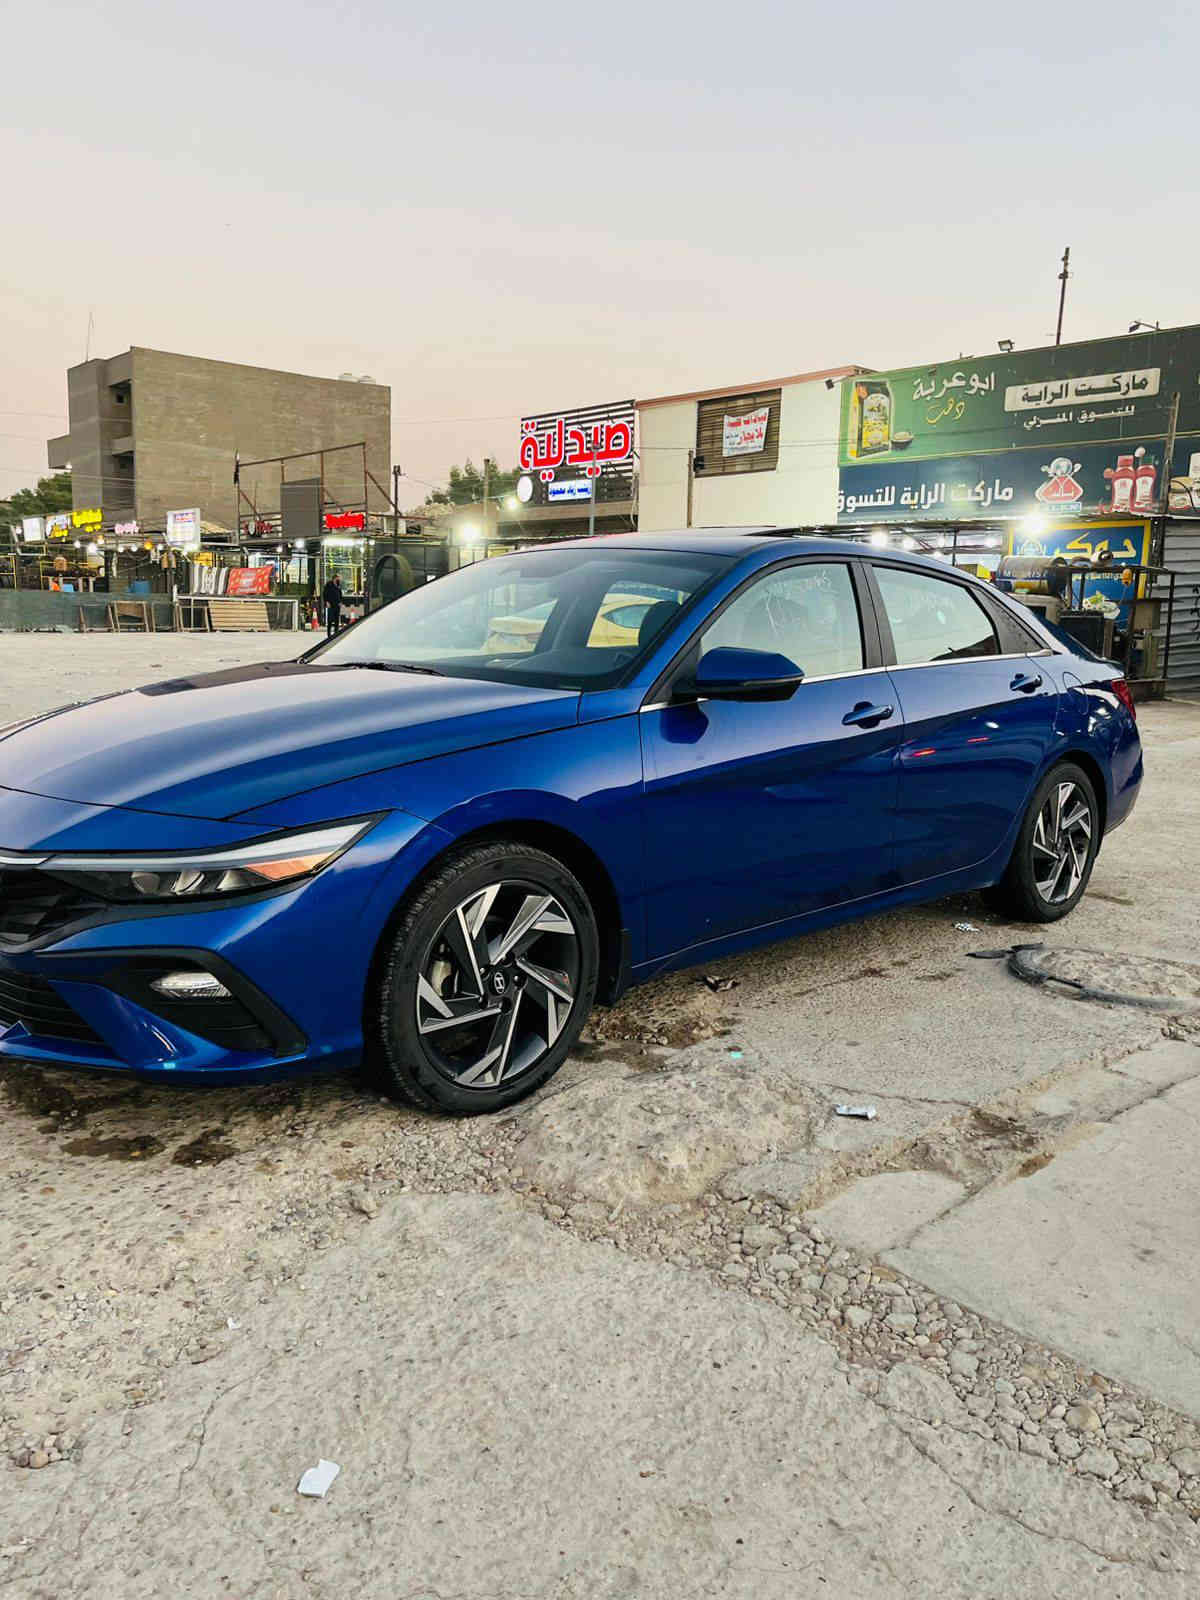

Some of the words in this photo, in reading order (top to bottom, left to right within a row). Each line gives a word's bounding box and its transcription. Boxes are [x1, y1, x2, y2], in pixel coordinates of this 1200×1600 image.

[1021, 382, 1069, 405] الراية
[1075, 374, 1149, 396] ماركت
[520, 416, 632, 482] صيدلية
[837, 485, 896, 513] للتسوق
[900, 482, 945, 510] الراية
[952, 479, 1014, 507] ماركت
